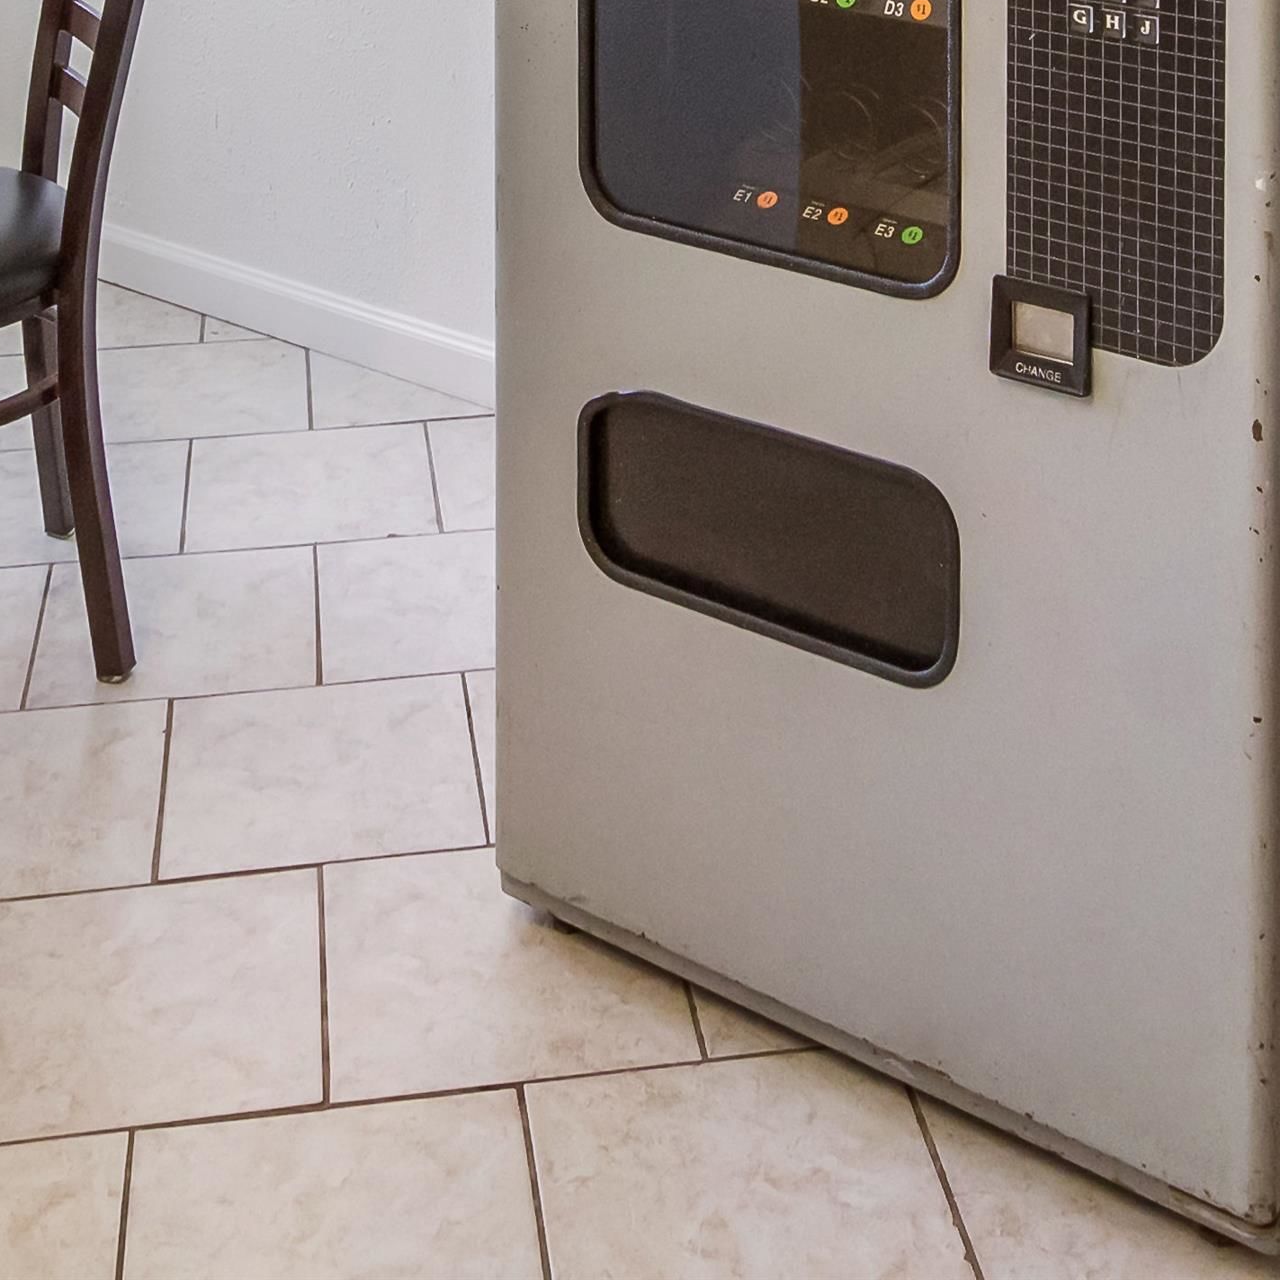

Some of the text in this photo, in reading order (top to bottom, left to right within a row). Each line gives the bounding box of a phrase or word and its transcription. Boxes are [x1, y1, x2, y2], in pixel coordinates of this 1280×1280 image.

[884, 0, 905, 17] D3
[1073, 10, 1151, 35] G H J
[732, 189, 751, 203] E1
[802, 206, 823, 220] E2
[874, 223, 895, 238] E3
[1015, 361, 1062, 383] CHANGE
